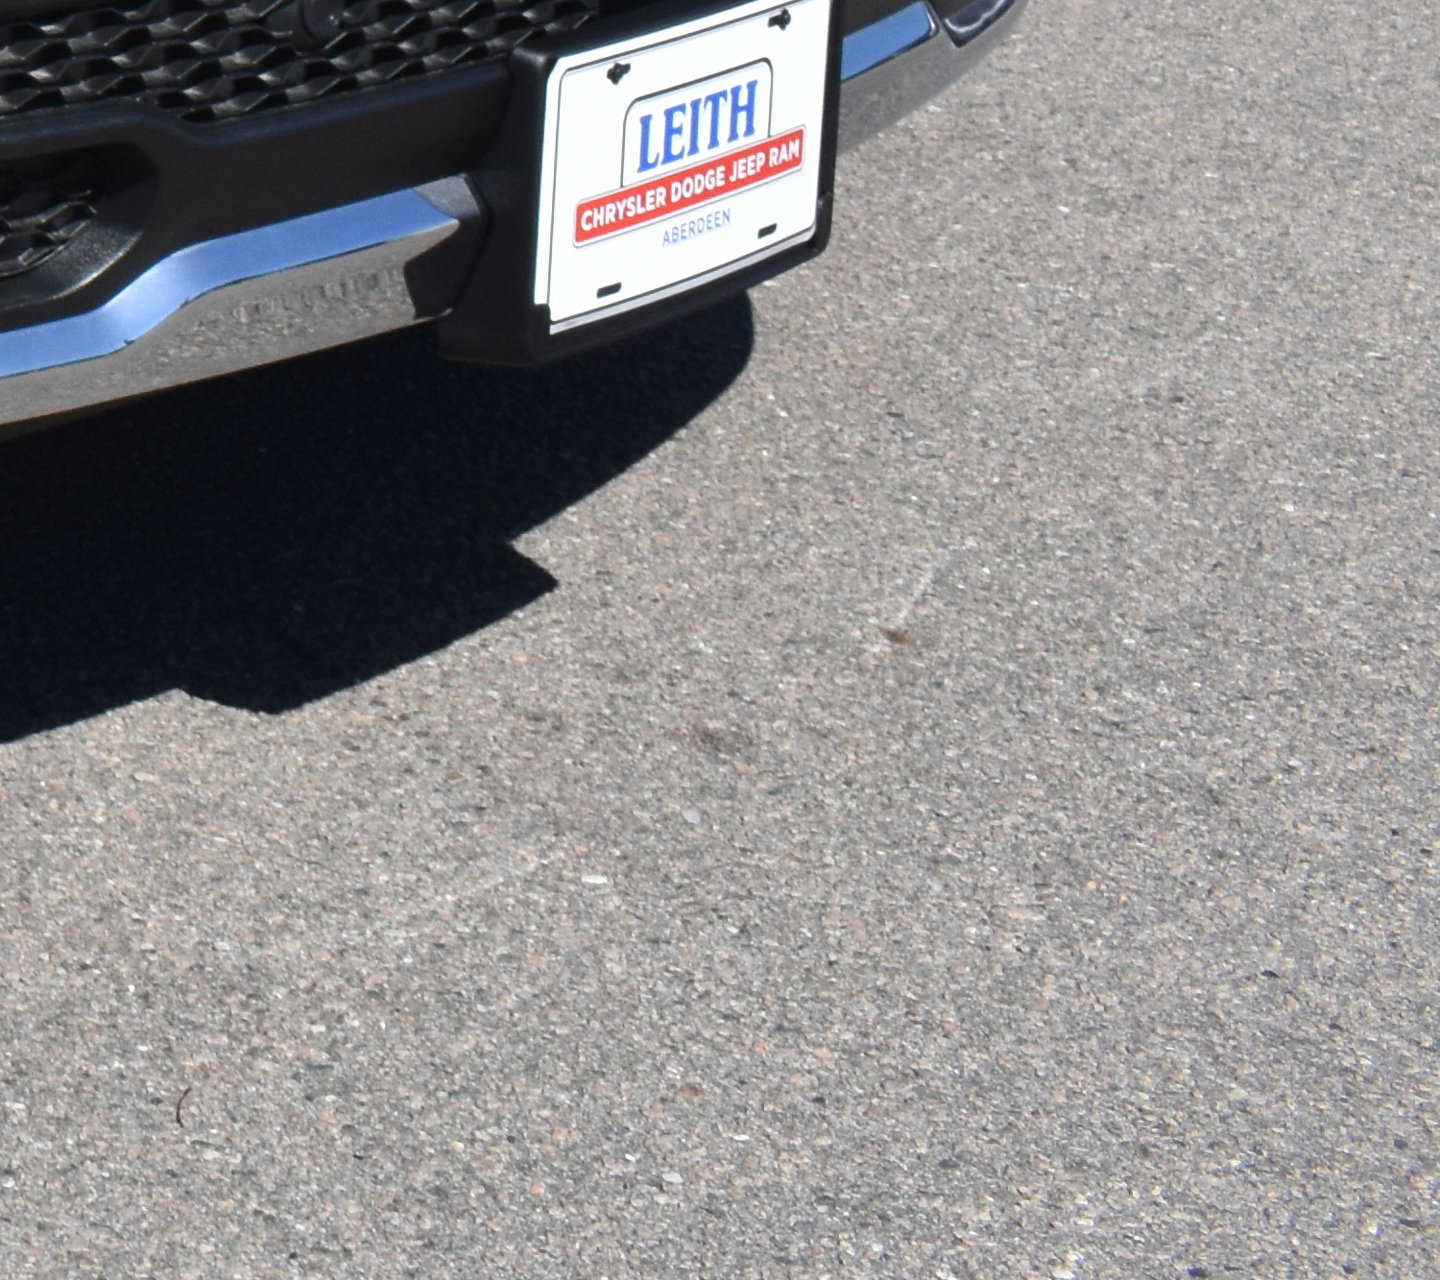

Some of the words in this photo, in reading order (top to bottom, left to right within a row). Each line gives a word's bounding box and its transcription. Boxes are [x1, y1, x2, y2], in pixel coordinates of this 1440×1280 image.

[637, 79, 759, 174] LEITH
[581, 186, 667, 232] CHRYSLER
[670, 165, 726, 204] DODGE
[728, 151, 766, 184] JEEP
[769, 138, 801, 169] RAM
[661, 207, 732, 248] ABERDEEN
